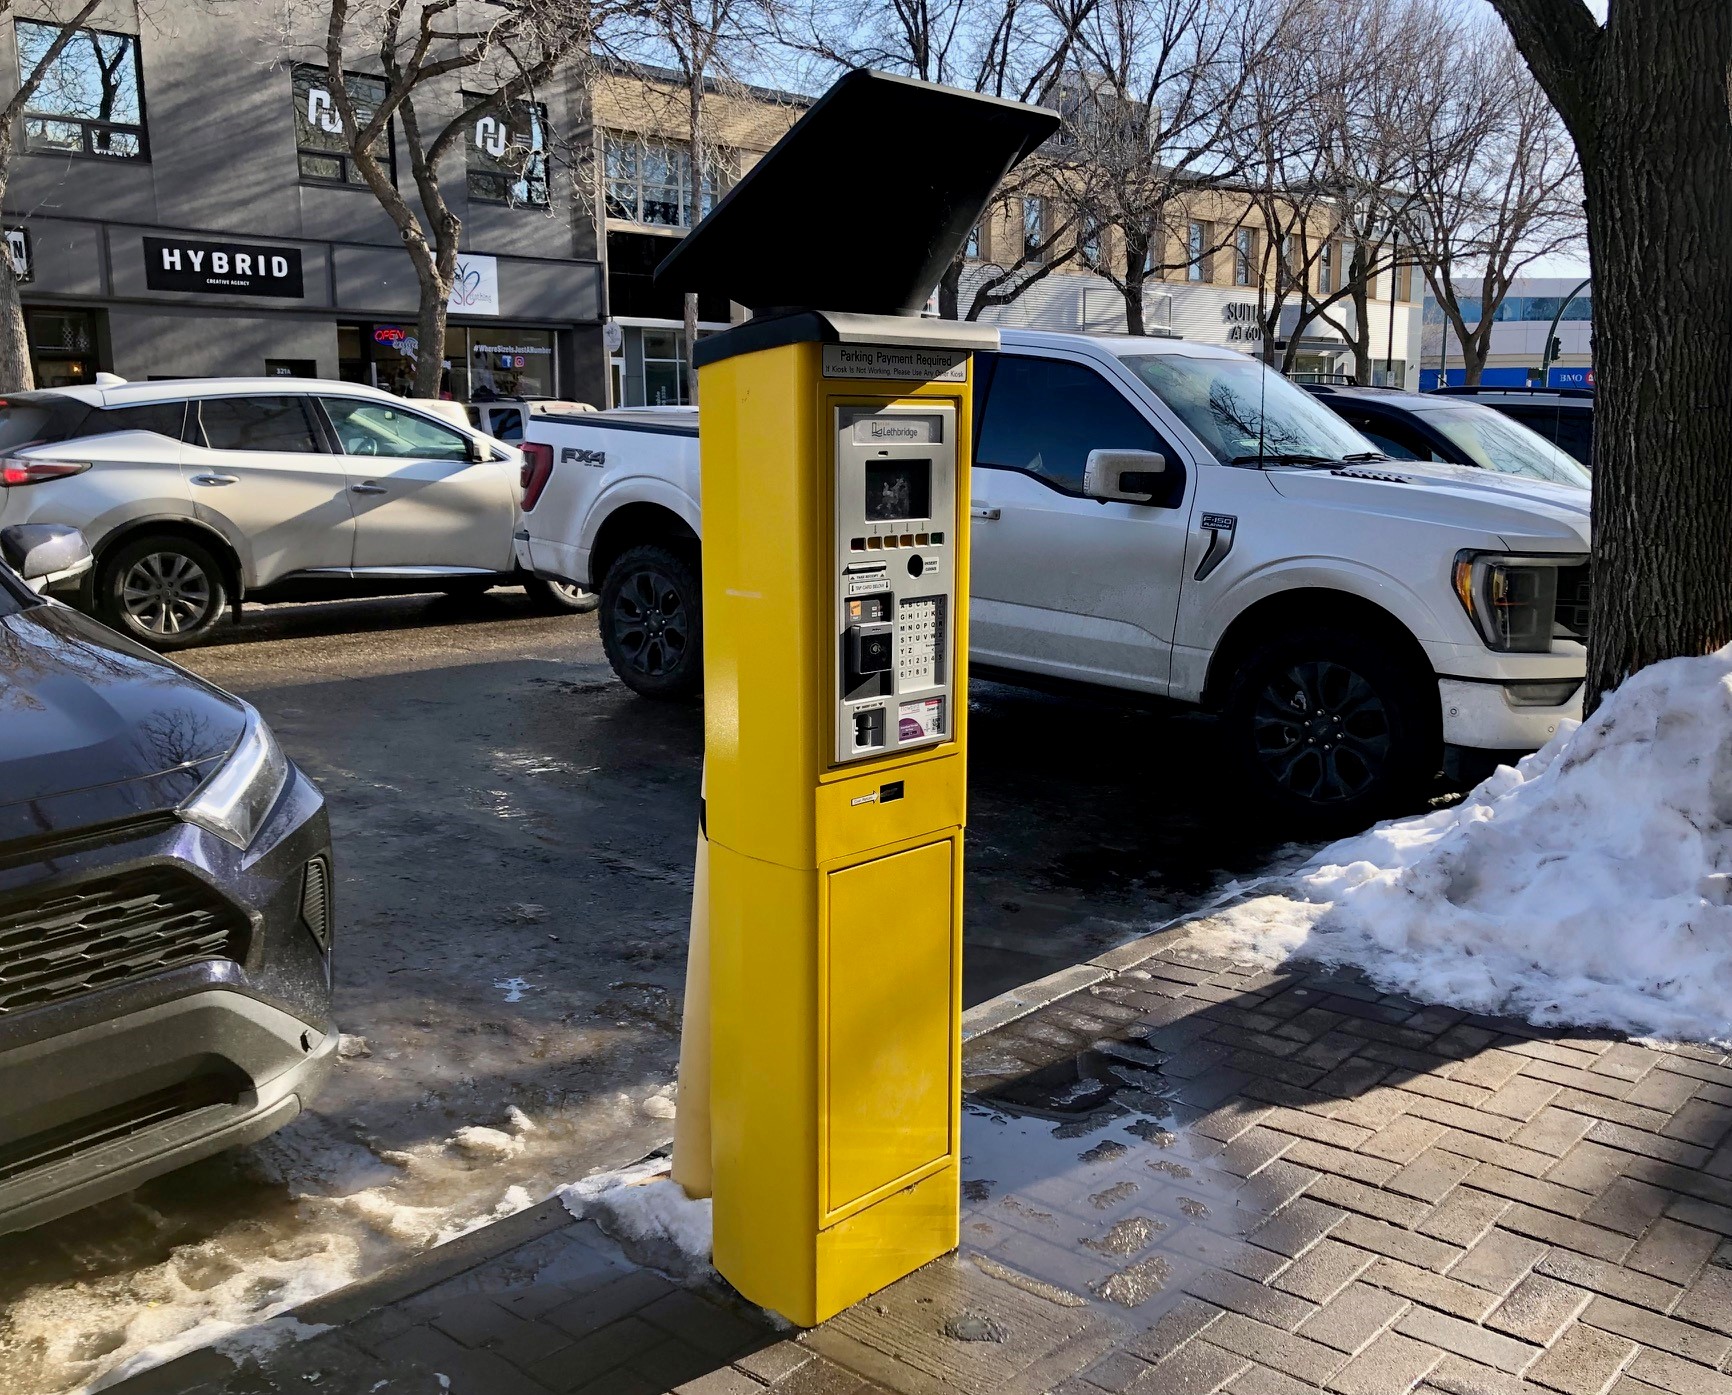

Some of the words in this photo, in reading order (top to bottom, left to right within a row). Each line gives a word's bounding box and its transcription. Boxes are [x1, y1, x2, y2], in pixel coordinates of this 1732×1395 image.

[162, 248, 288, 277] HYBRID
[374, 329, 406, 341] OPEN
[1231, 325, 1242, 340] AT
[840, 349, 873, 365] Parking
[876, 351, 914, 366] Payment
[916, 353, 952, 368] Required
[276, 367, 292, 375] 321A
[825, 365, 830, 373] If
[832, 365, 847, 373] Kiosk
[849, 366, 854, 374] Is
[856, 366, 867, 374] Not
[893, 368, 911, 376] Please
[923, 370, 934, 378] Any
[1560, 374, 1583, 382] BMO
[883, 427, 918, 439] Lethbridge
[561, 447, 605, 465] FX4
[1203, 516, 1232, 525] F-150
